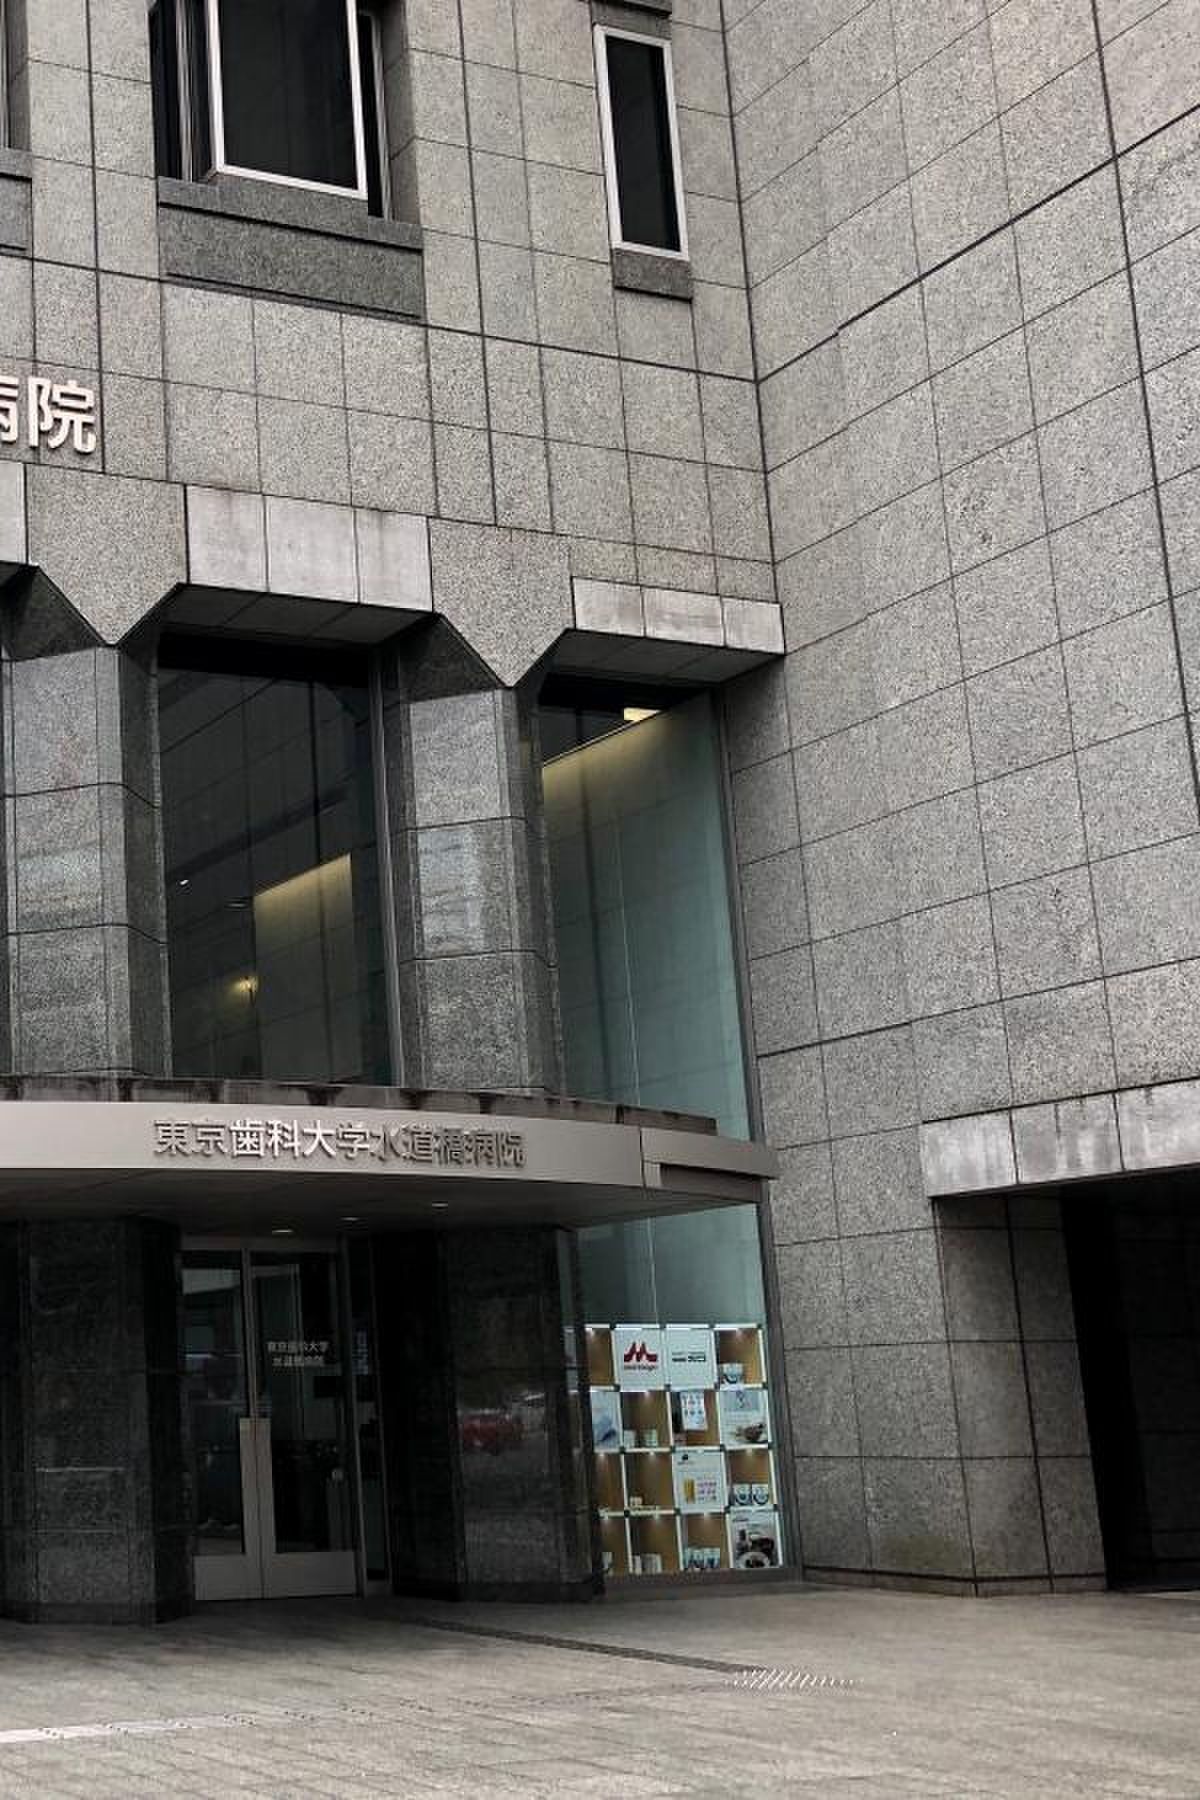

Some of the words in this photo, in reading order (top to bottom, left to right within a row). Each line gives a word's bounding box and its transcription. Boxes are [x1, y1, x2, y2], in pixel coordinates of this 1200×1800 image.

[154, 1119, 526, 1167] 東京歯科大学水道橋病院
